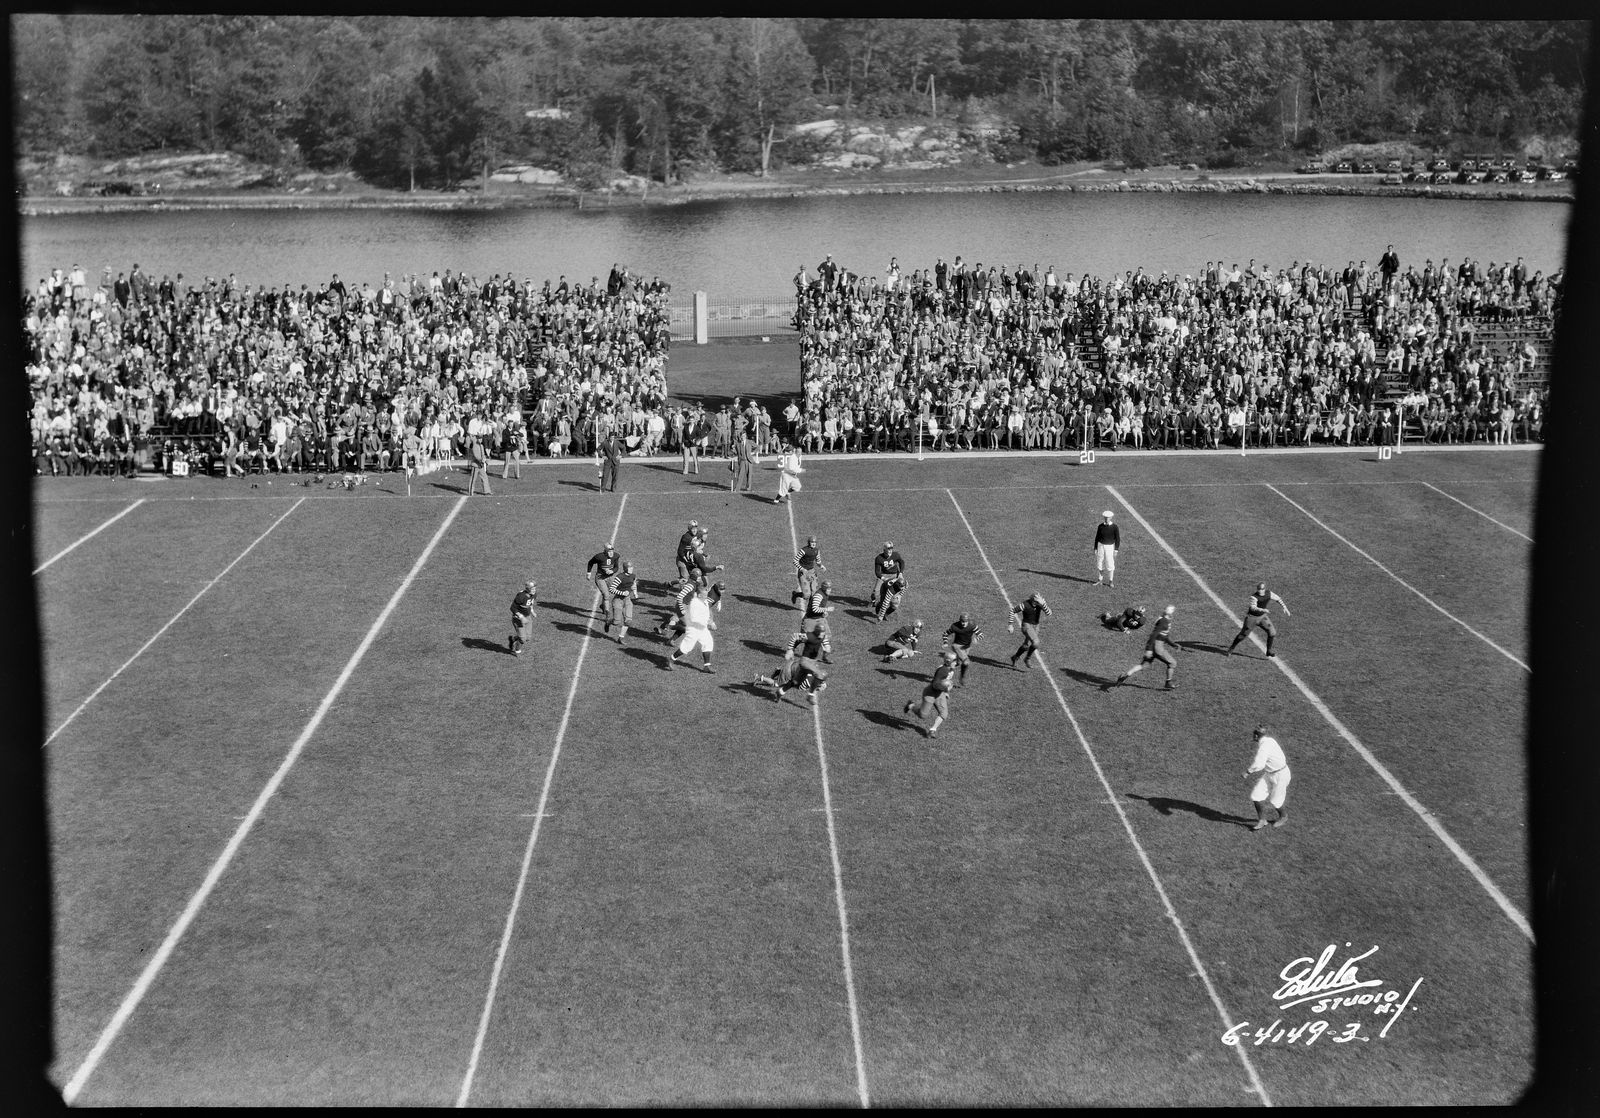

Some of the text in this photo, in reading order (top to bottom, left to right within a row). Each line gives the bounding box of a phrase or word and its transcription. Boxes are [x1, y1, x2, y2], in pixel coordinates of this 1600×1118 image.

[1080, 451, 1095, 464] 20
[1378, 447, 1391, 460] 10
[172, 461, 188, 476] 50
